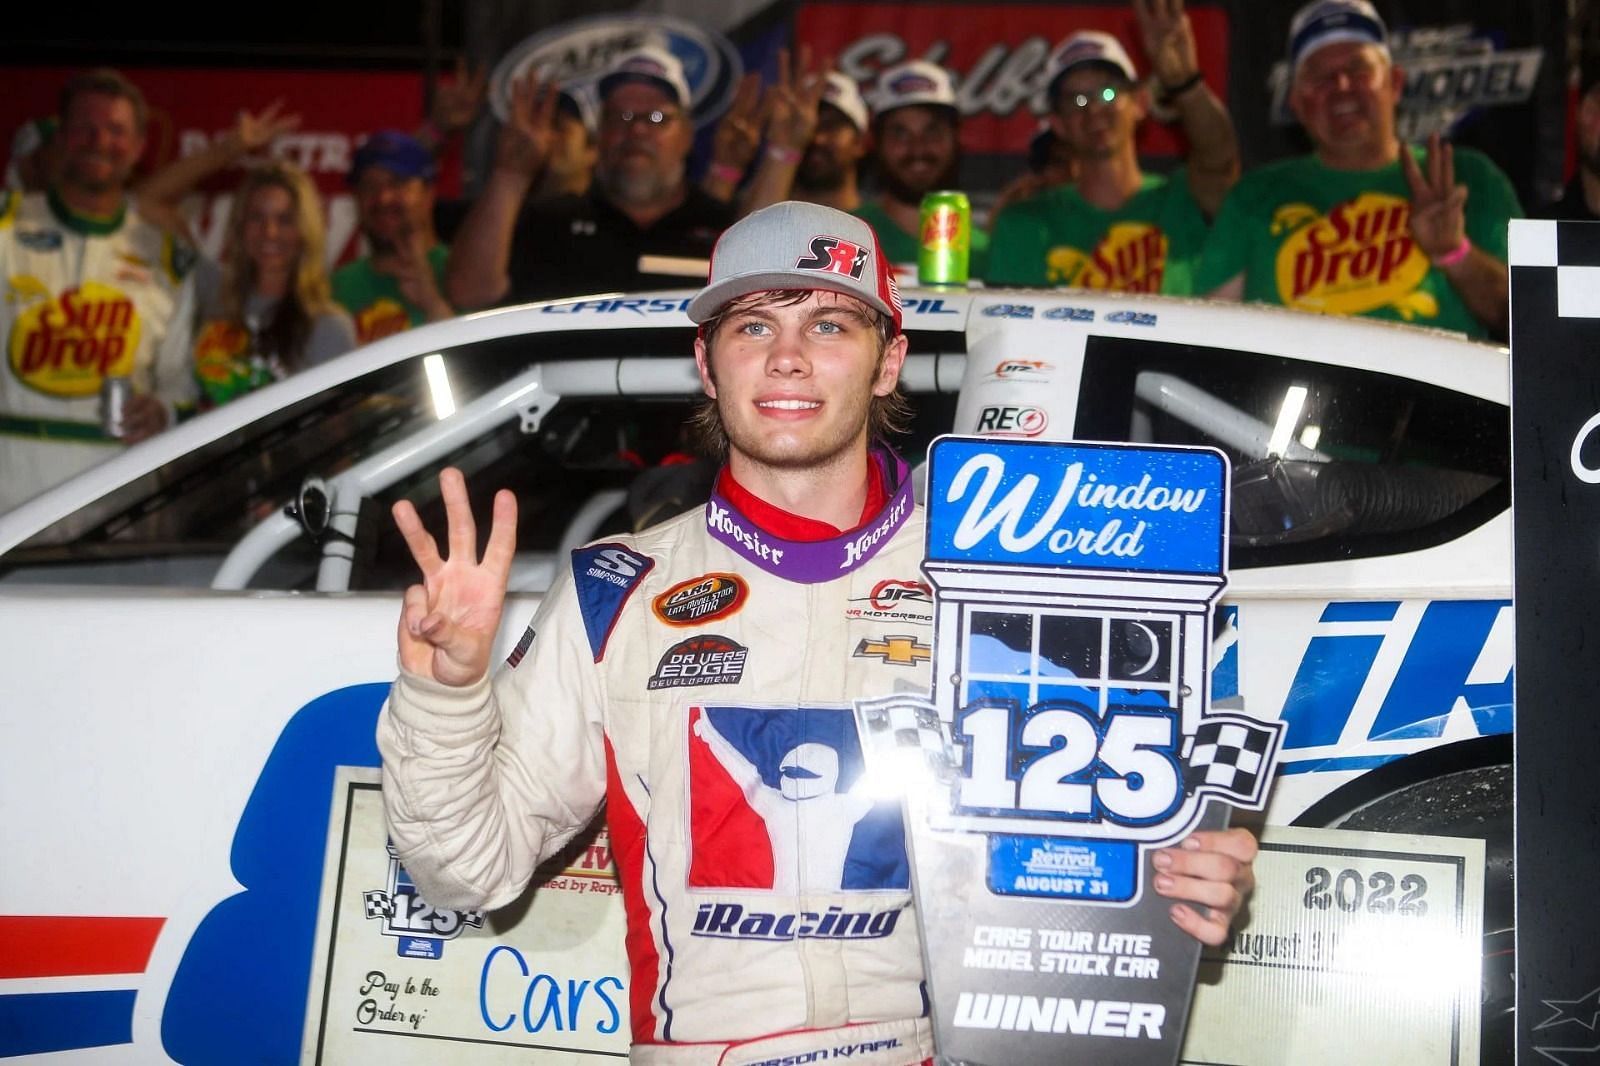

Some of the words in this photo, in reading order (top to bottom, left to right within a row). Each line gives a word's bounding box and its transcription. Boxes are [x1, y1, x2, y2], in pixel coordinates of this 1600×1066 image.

[1293, 237, 1414, 300] Drop
[38, 285, 134, 334] Sun
[21, 326, 126, 378] Drop
[707, 500, 784, 566] Hoosier
[839, 494, 908, 569] Hoosier
[586, 567, 628, 588] SIMPSON
[711, 586, 734, 600] STOCK
[689, 599, 719, 618] TOUR
[863, 610, 933, 621] MOTORSPO
[649, 674, 739, 689] DEVELOPMENT
[660, 660, 744, 679] EDGE
[957, 703, 1181, 822] 125
[570, 879, 588, 895] by
[1013, 875, 1085, 894] AUGUST
[1089, 880, 1110, 895] 31
[1302, 866, 1429, 917] 2022
[390, 894, 459, 932] 125
[692, 903, 904, 939] iRacing
[973, 925, 1032, 949] CARS
[1037, 928, 1095, 954] TOUR
[1098, 933, 1152, 956] LATE
[962, 946, 1035, 972] MODEL
[1038, 950, 1110, 978] STOCK
[1113, 956, 1160, 980] CAR
[359, 970, 401, 1002] Pay
[404, 976, 417, 994] to
[420, 977, 441, 997] the
[480, 946, 625, 1034] Cars
[356, 998, 405, 1025] Order
[953, 992, 1167, 1040] WINNER
